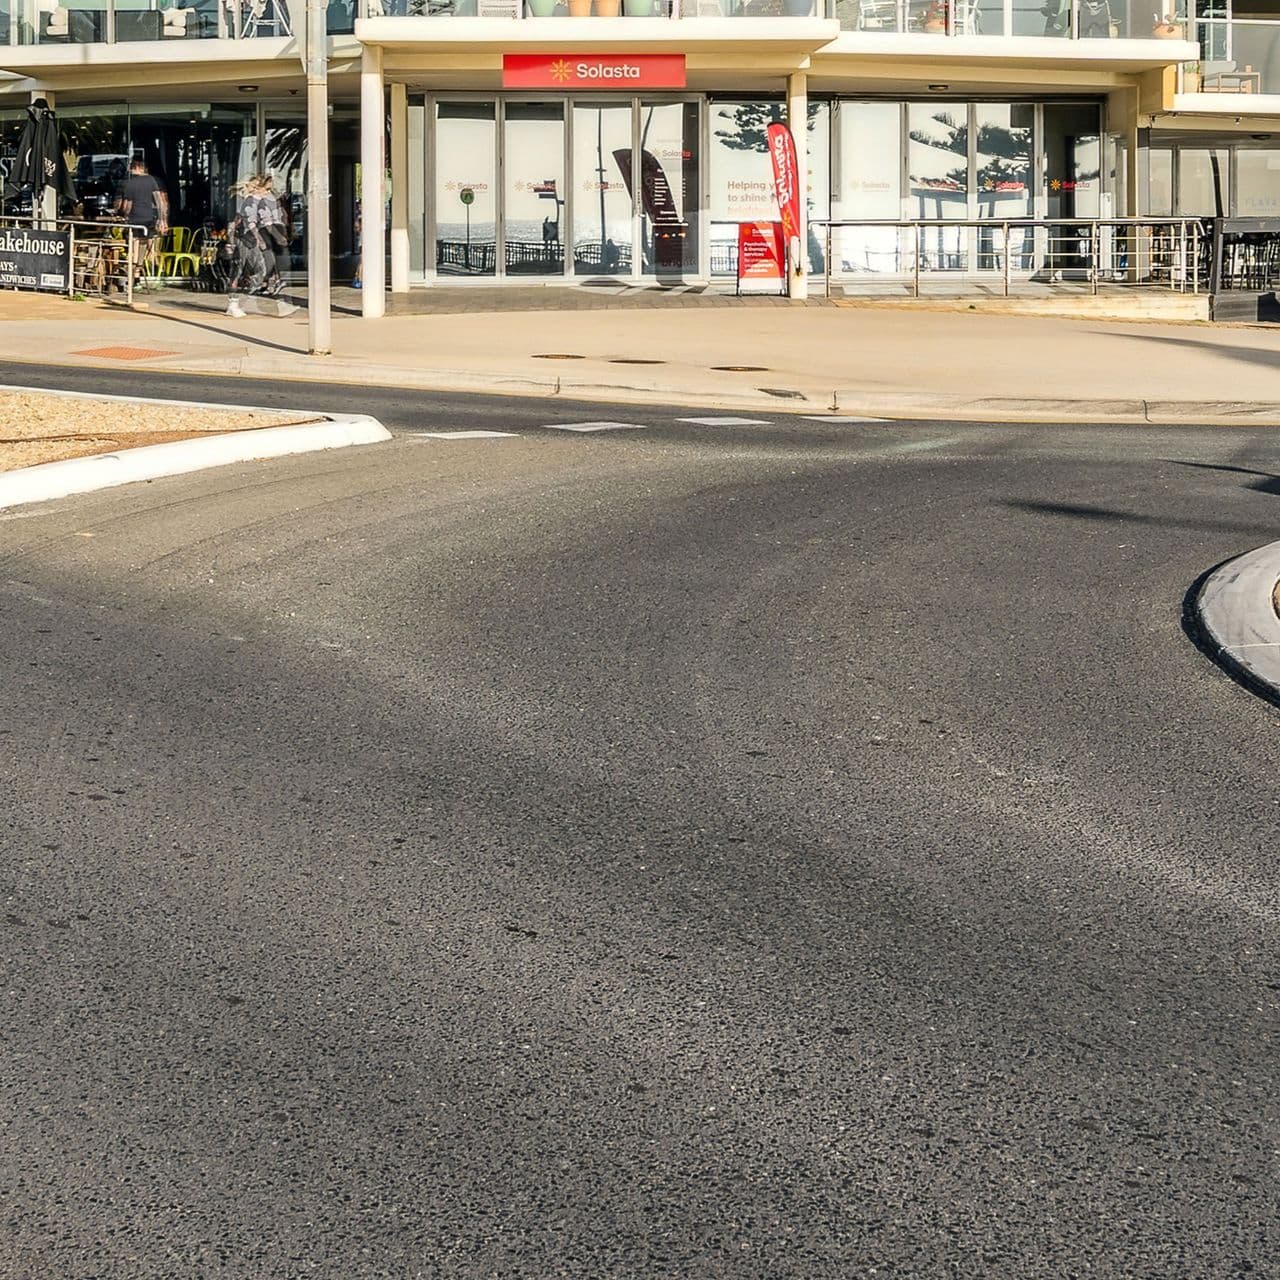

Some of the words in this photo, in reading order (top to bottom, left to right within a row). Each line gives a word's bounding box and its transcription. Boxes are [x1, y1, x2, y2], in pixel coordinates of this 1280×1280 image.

[576, 63, 640, 79] Solasta
[727, 180, 767, 192] Helping
[727, 193, 738, 202] to
[740, 192, 767, 202] shine
